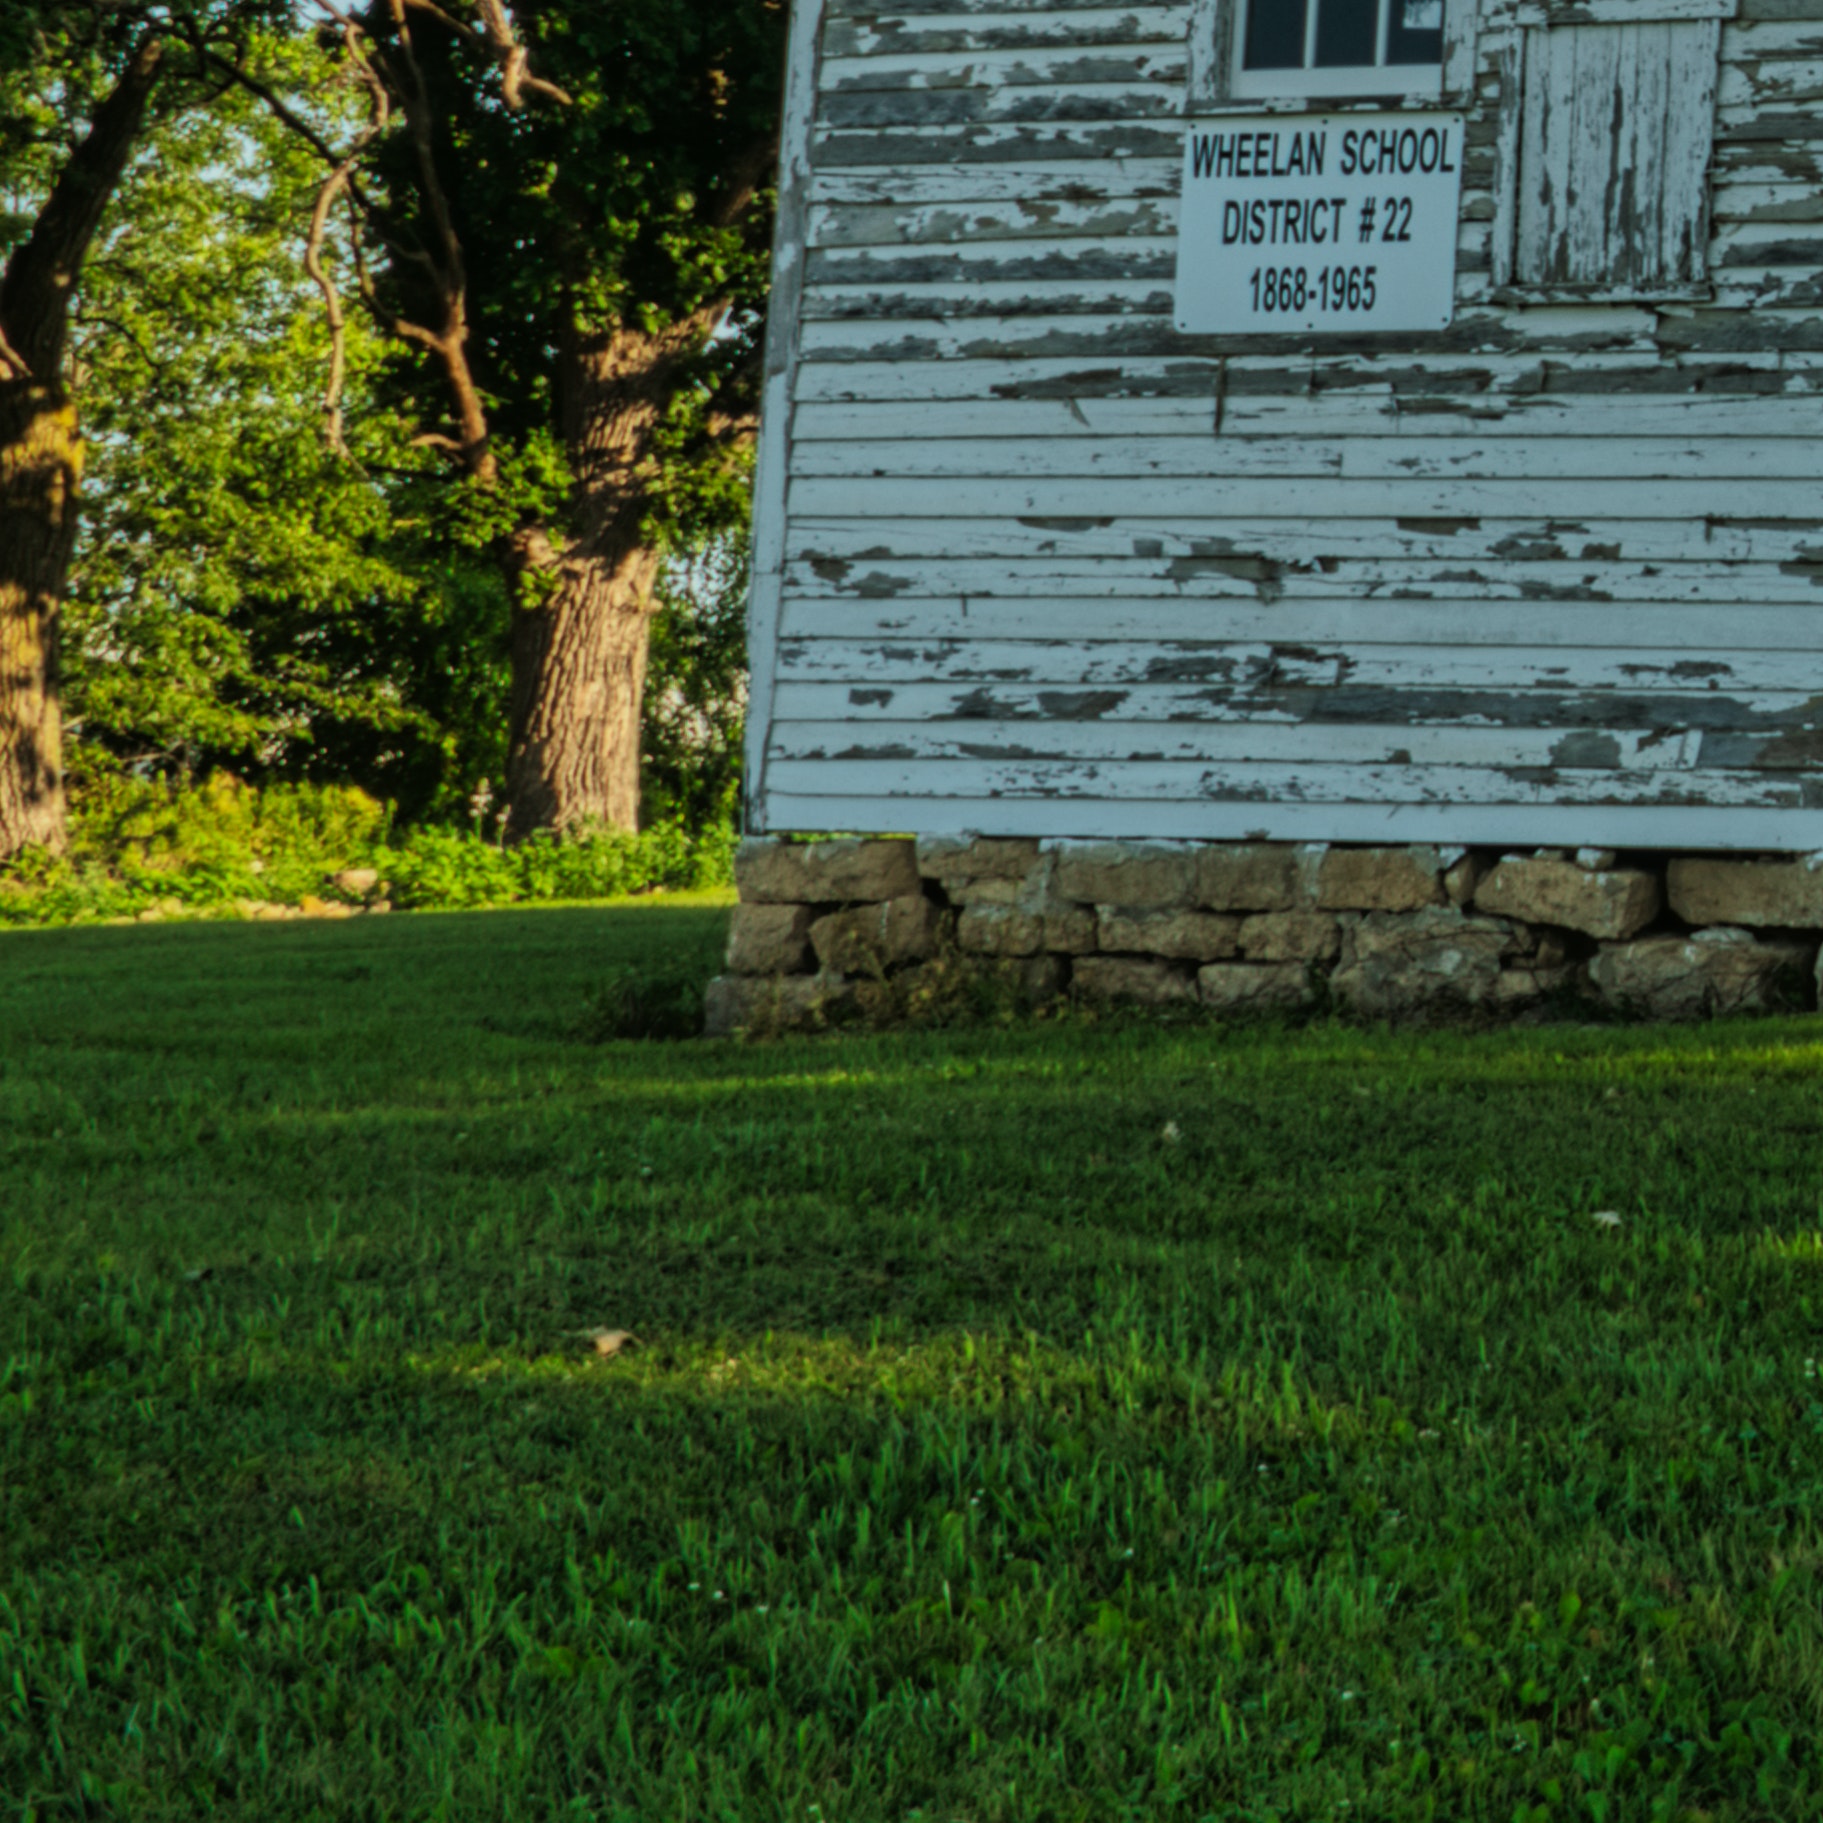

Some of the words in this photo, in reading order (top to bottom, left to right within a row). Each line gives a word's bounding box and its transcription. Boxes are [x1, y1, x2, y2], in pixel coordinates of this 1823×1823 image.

[1193, 131, 1327, 179] WHEELAN
[1340, 127, 1455, 176] SCHOOL
[1221, 197, 1347, 245] DISTRICT
[1249, 265, 1378, 313] 1868-1965
